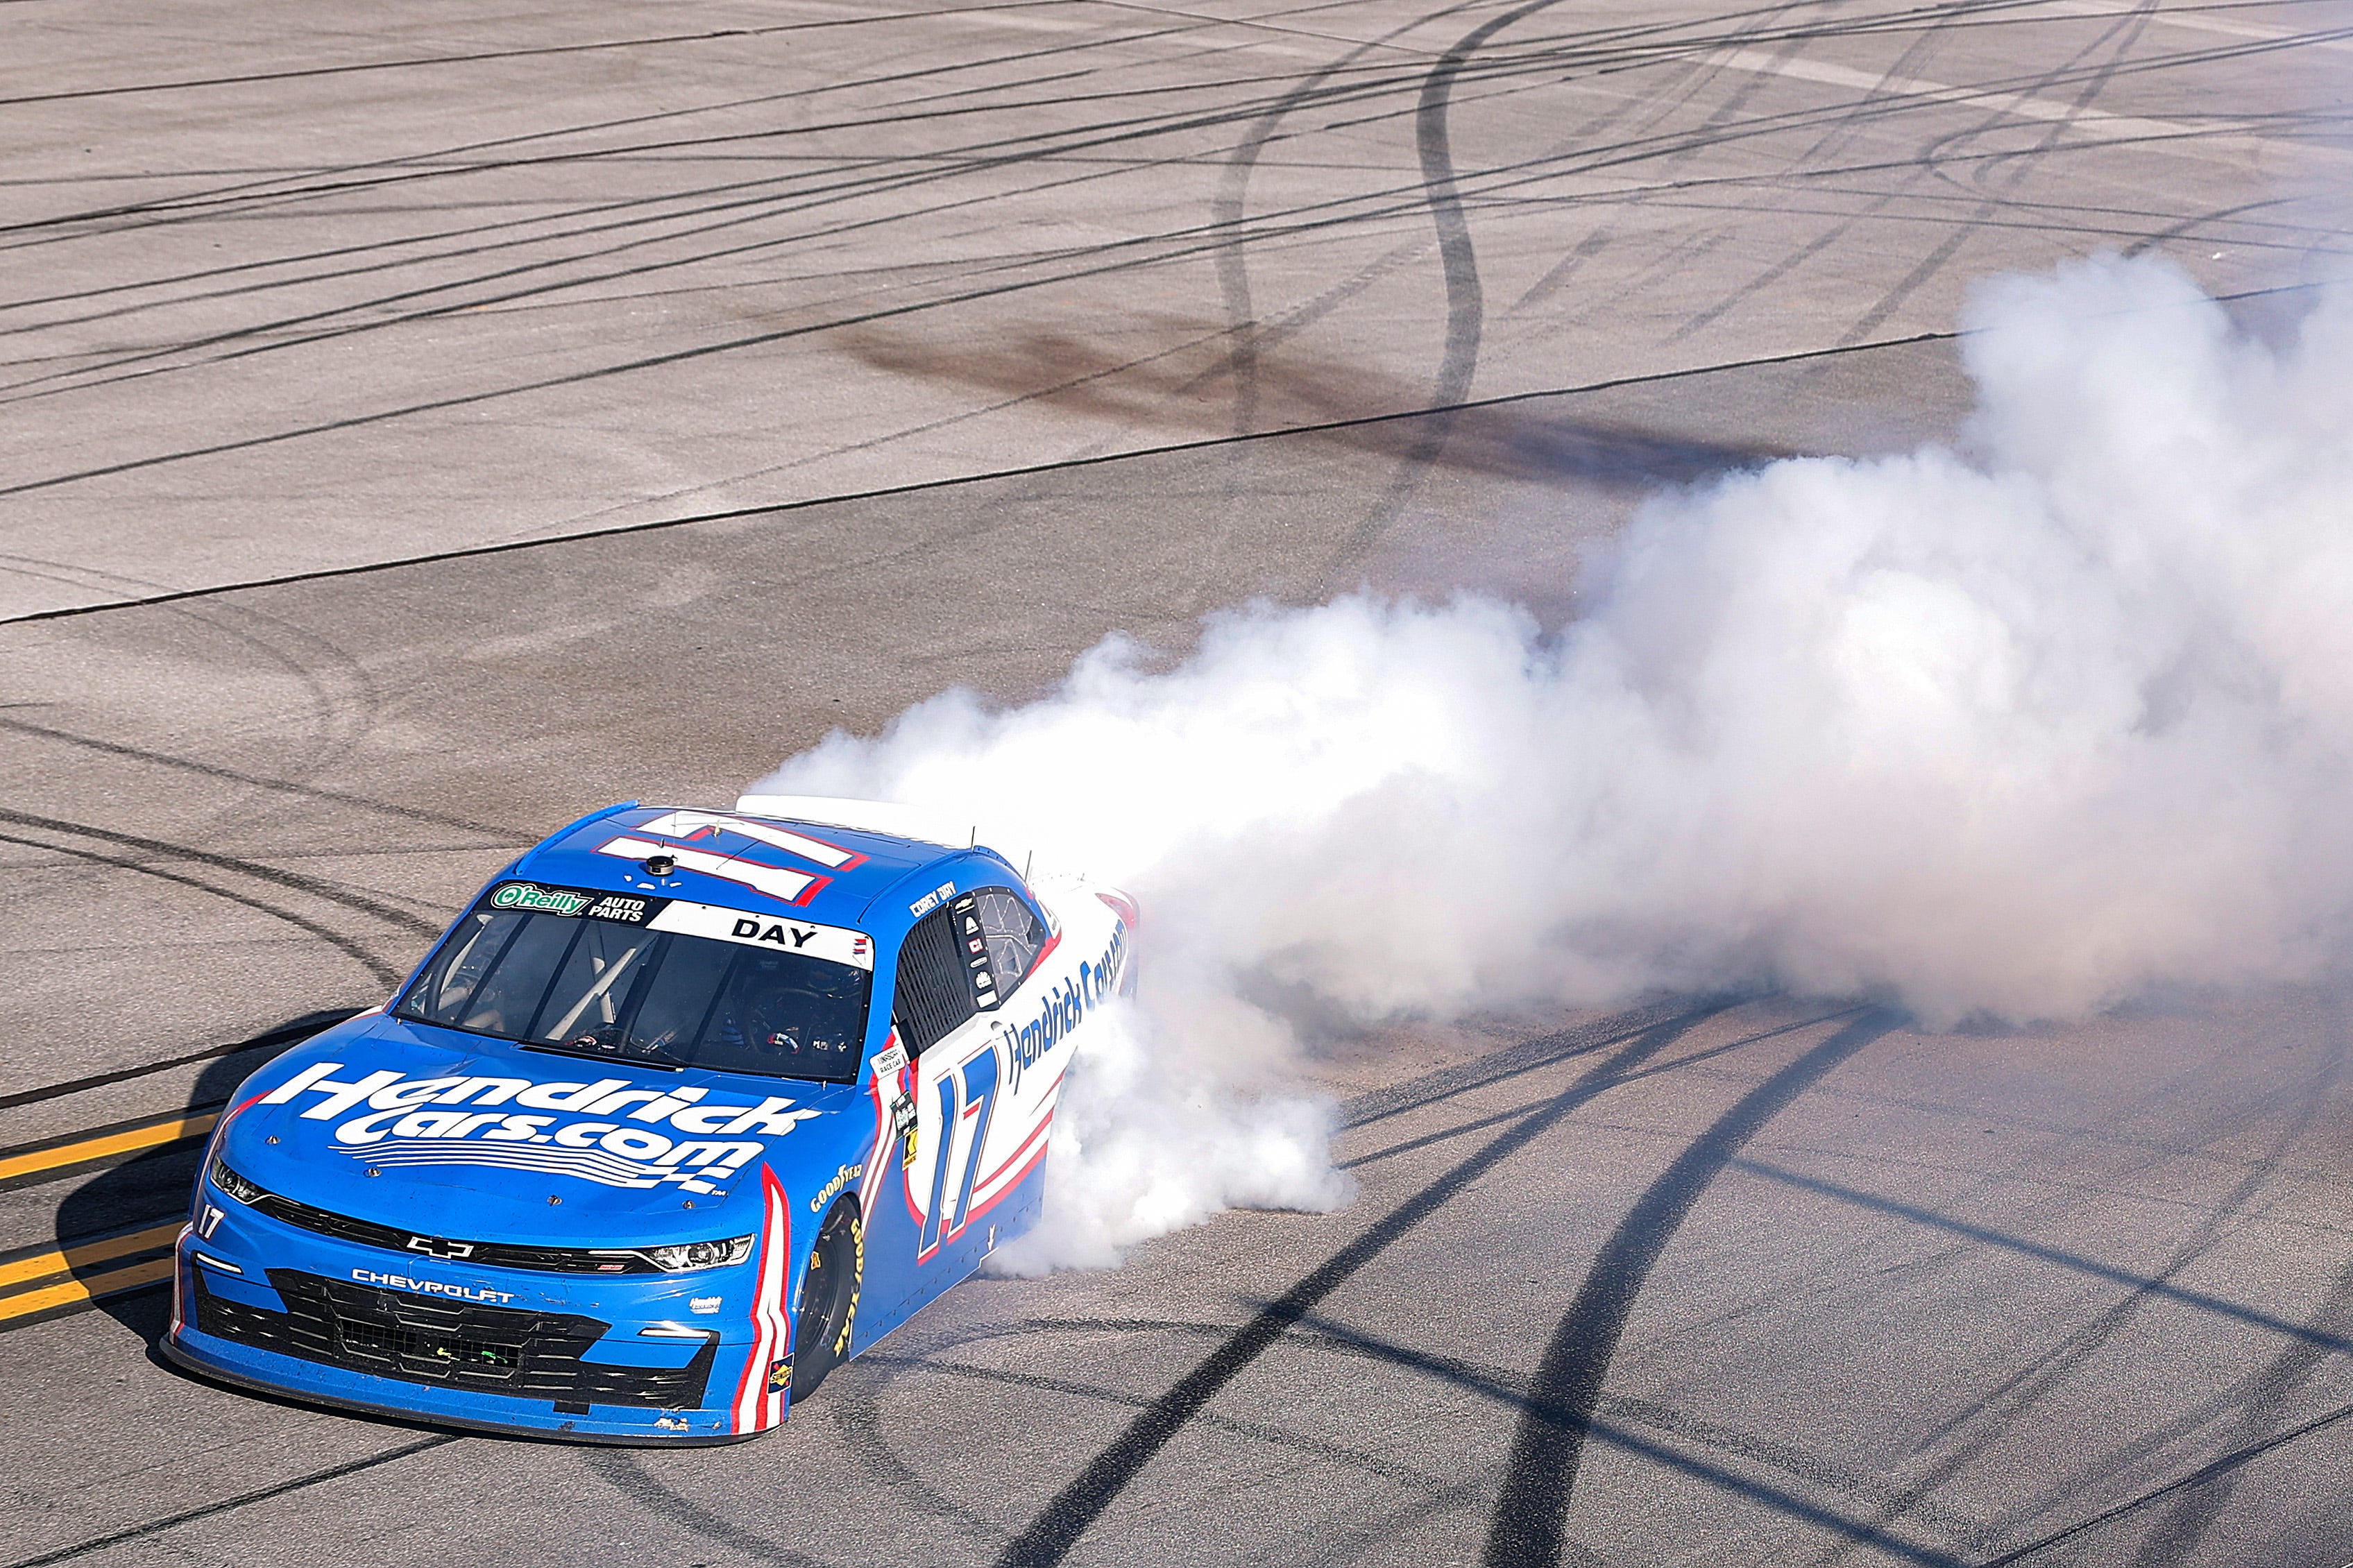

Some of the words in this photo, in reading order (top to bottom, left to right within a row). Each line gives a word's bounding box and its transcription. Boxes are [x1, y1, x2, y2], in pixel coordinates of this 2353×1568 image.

[591, 810, 870, 907] 17
[493, 885, 588, 915] O'Reilly
[588, 905, 644, 922] PARTS
[600, 896, 646, 911] AUTO
[909, 890, 940, 918] COREY
[937, 881, 957, 901] DAY
[731, 919, 818, 948] DAY
[259, 1062, 822, 1136] Hendrick
[335, 1103, 765, 1168] Cars.com
[918, 1042, 1000, 1264] 17
[810, 1164, 863, 1213] GOODYEAR
[198, 1204, 225, 1239] 17
[352, 1268, 515, 1303] CHEVROLET
